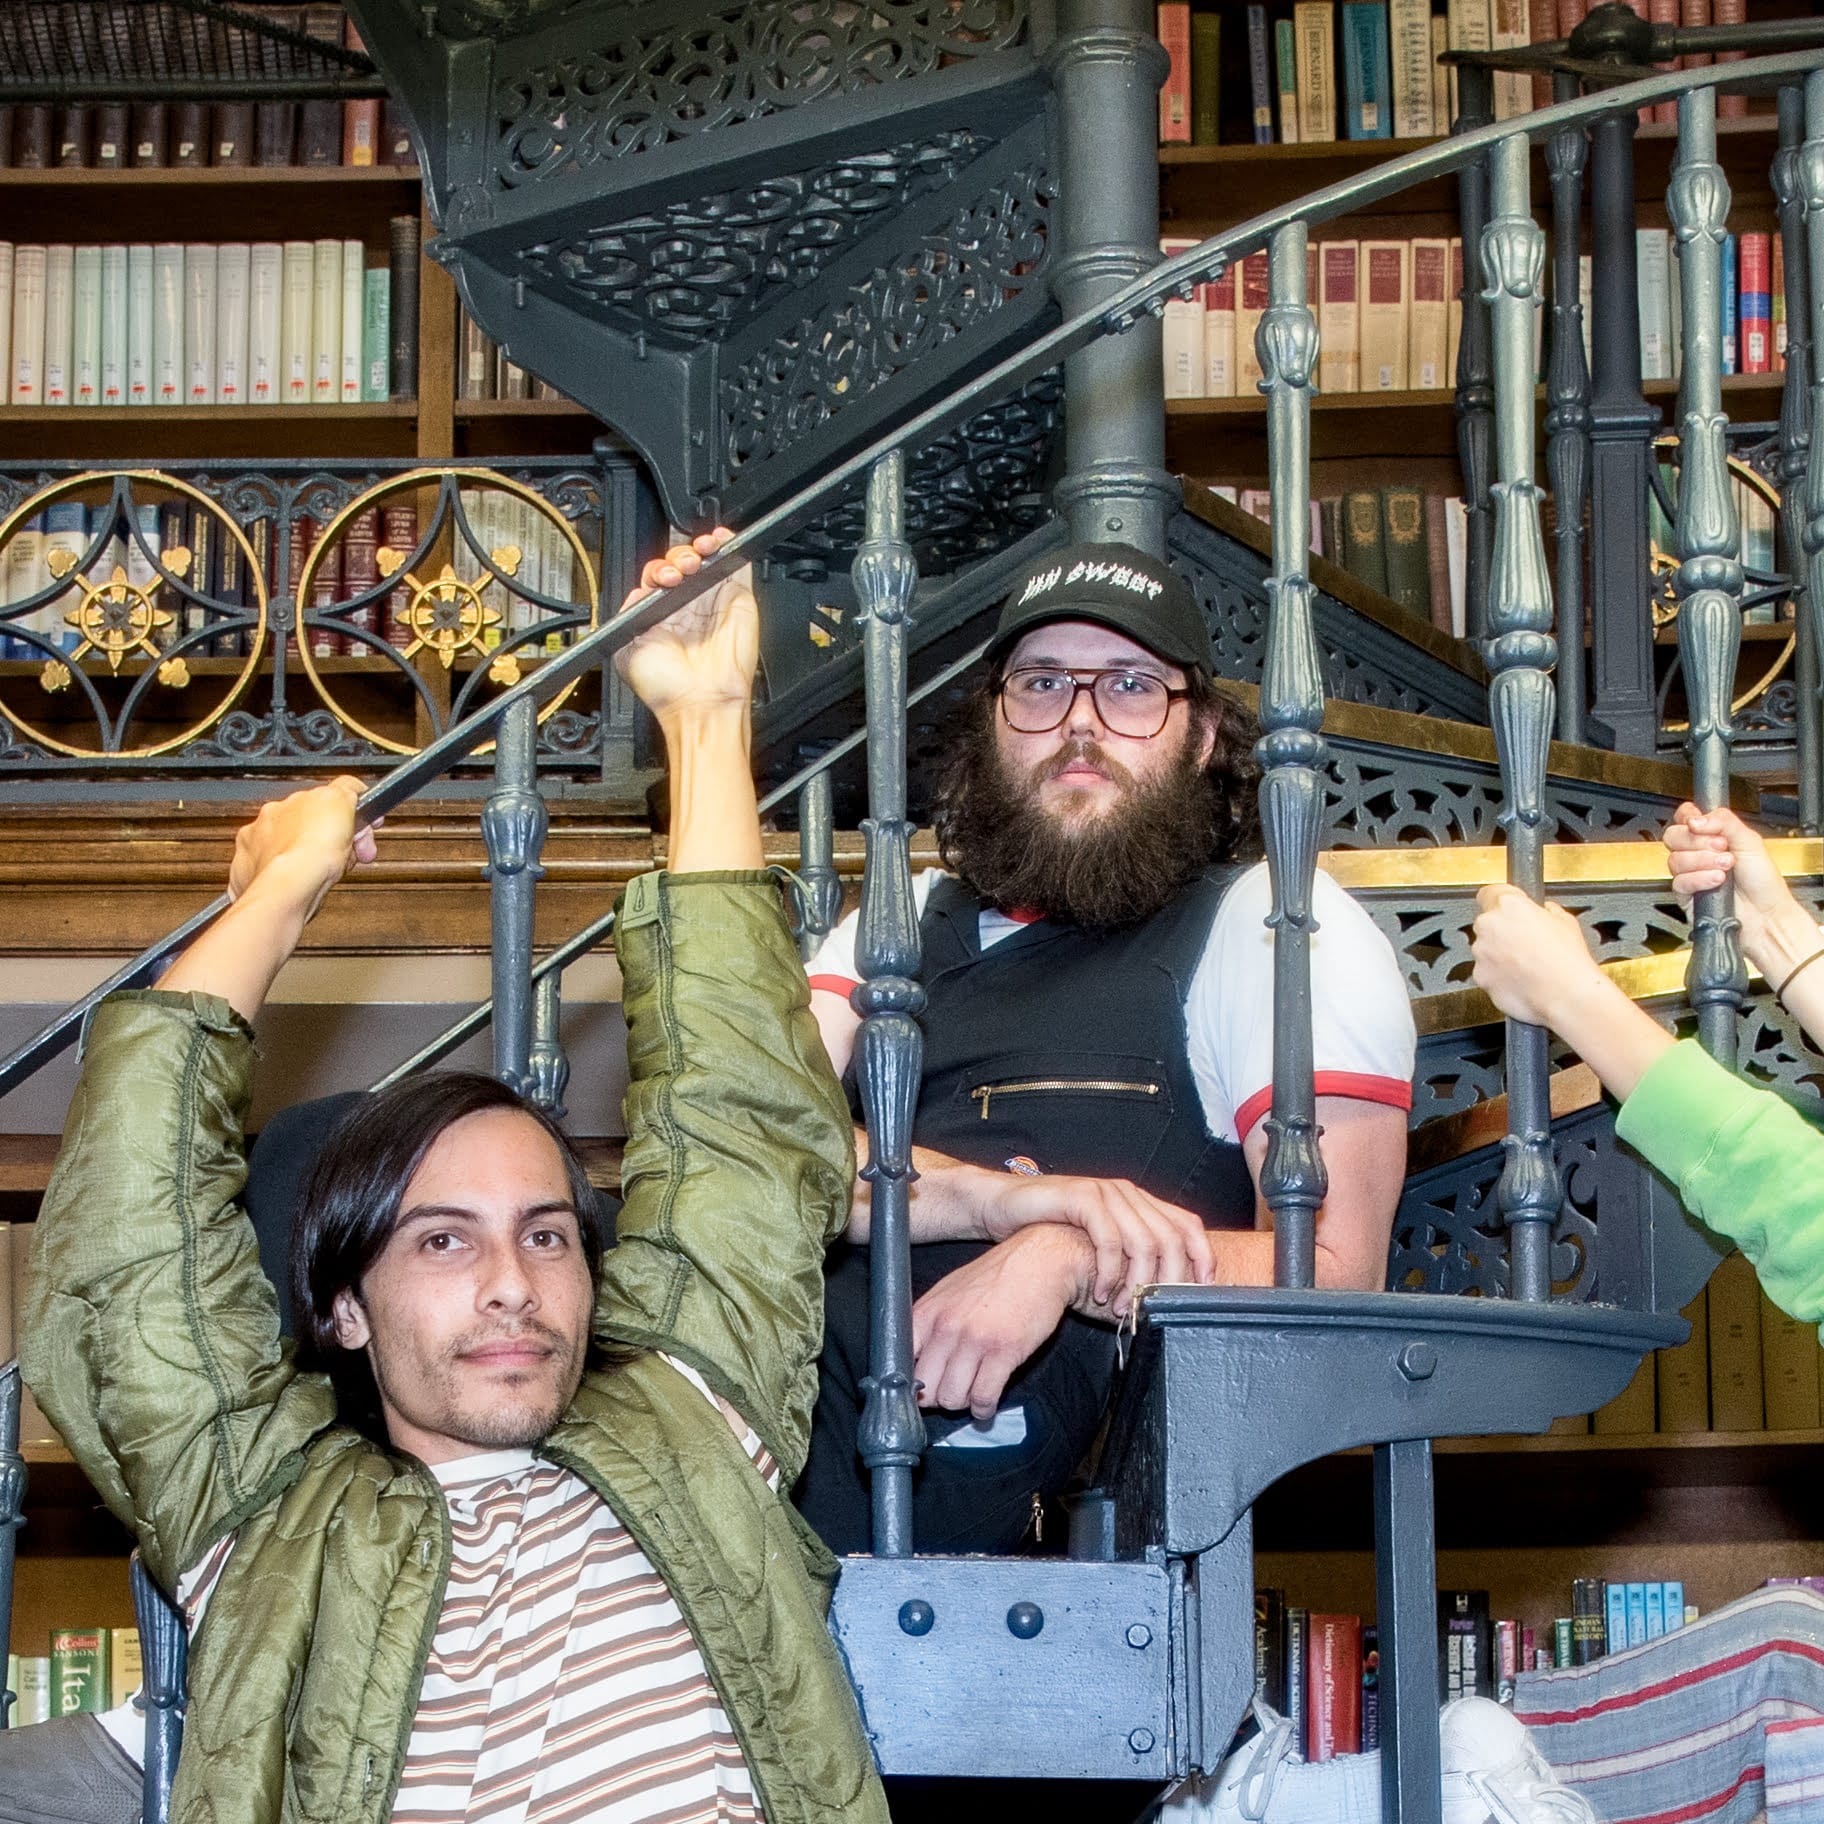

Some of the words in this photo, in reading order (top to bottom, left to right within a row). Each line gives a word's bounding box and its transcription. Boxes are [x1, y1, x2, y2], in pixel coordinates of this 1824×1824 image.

[1310, 31, 1321, 91] BERNARD
[68, 1637, 98, 1649] Collins
[1256, 1625, 1268, 1675] Academic
[1323, 1624, 1334, 1672] Dictionary
[1325, 1674, 1335, 1684] of
[1325, 1685, 1334, 1720] Science
[1325, 1722, 1335, 1741] and
